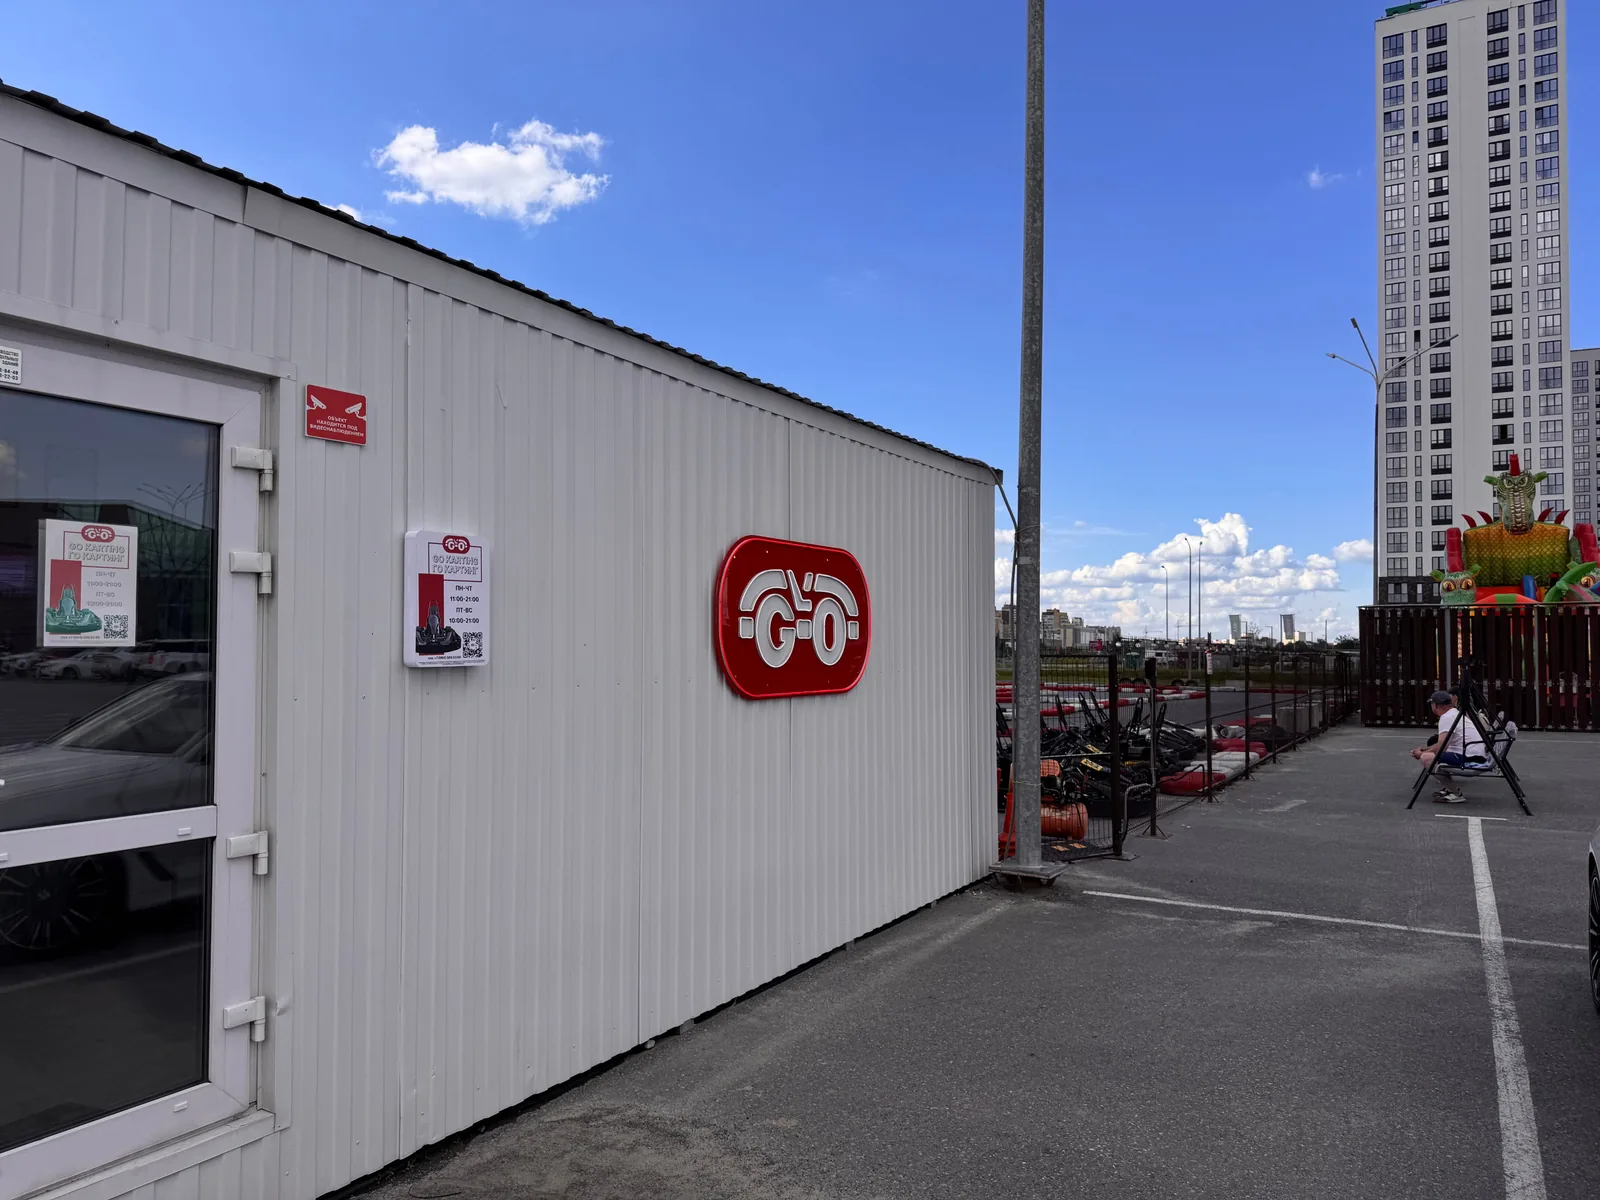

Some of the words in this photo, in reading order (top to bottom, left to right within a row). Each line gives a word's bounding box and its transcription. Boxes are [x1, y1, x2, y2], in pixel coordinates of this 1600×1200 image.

[316, 420, 346, 428] НАХОДИТСЯ
[310, 424, 364, 437] ВИДЕОНАБЛЮДЕНИЕМ
[69, 543, 83, 551] GO
[84, 544, 126, 554] KARTING
[68, 552, 80, 560] ГО
[82, 552, 125, 562] КАРТИНГ
[433, 554, 445, 564] GO
[446, 555, 479, 566] KARTING
[432, 564, 443, 573] ГО
[444, 564, 479, 575] КАРТИНГ
